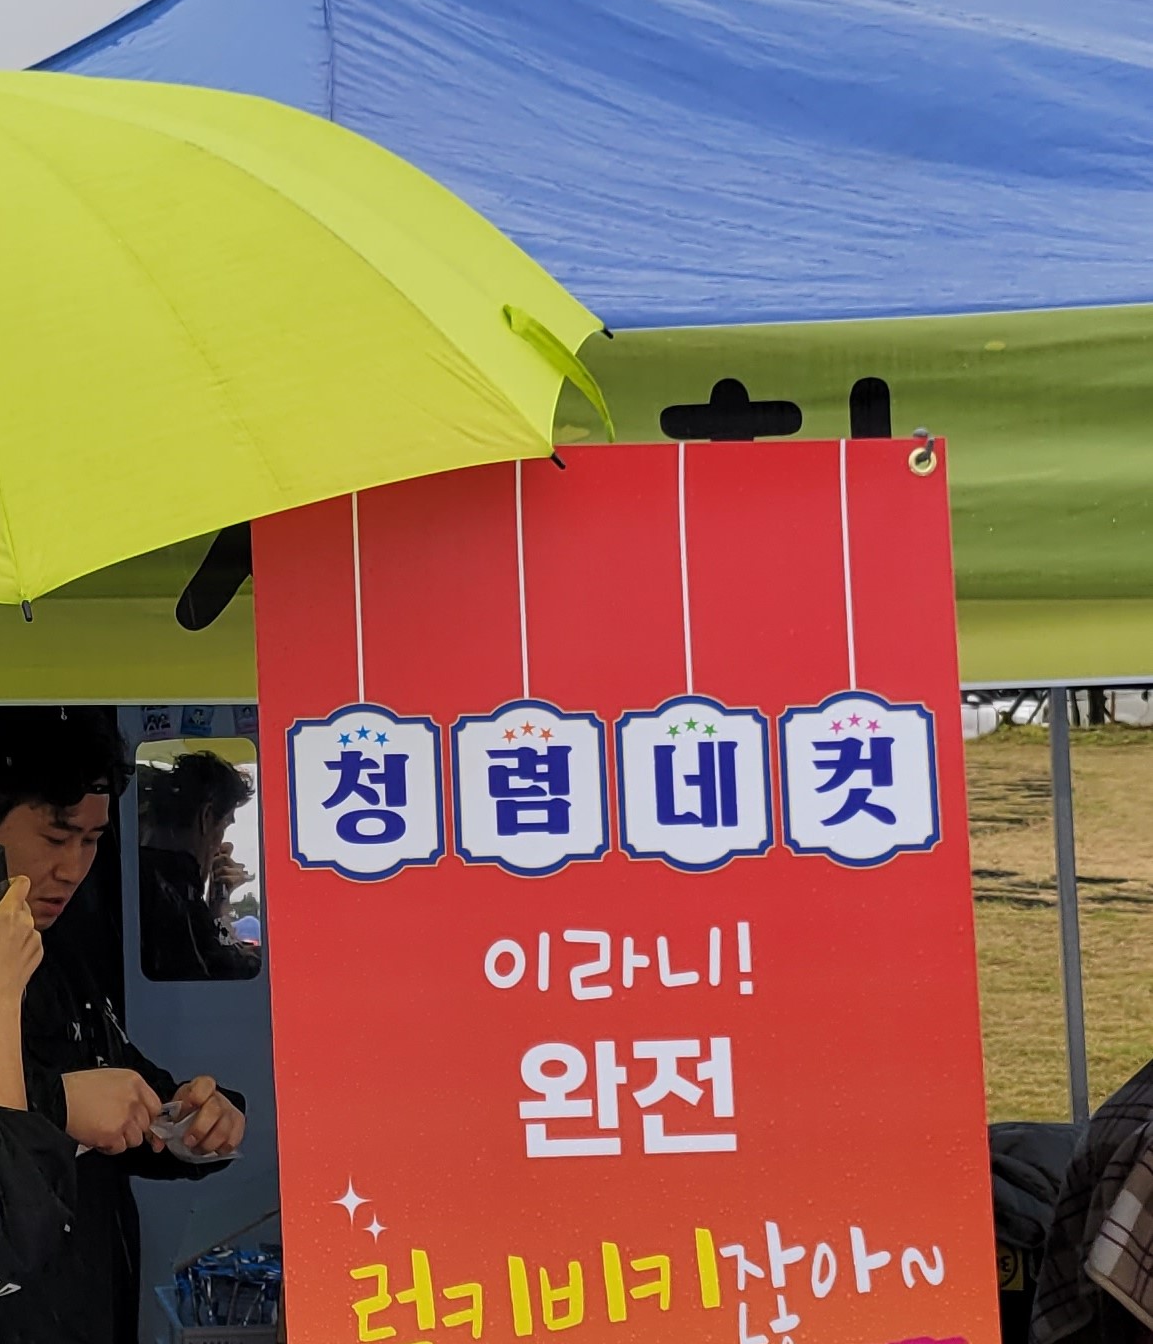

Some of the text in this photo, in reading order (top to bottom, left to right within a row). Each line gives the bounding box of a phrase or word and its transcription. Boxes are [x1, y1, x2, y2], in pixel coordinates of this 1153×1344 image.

[322, 736, 898, 846] 청렴네컷
[484, 921, 758, 1001] 이라니!
[518, 1036, 738, 1159] 완전
